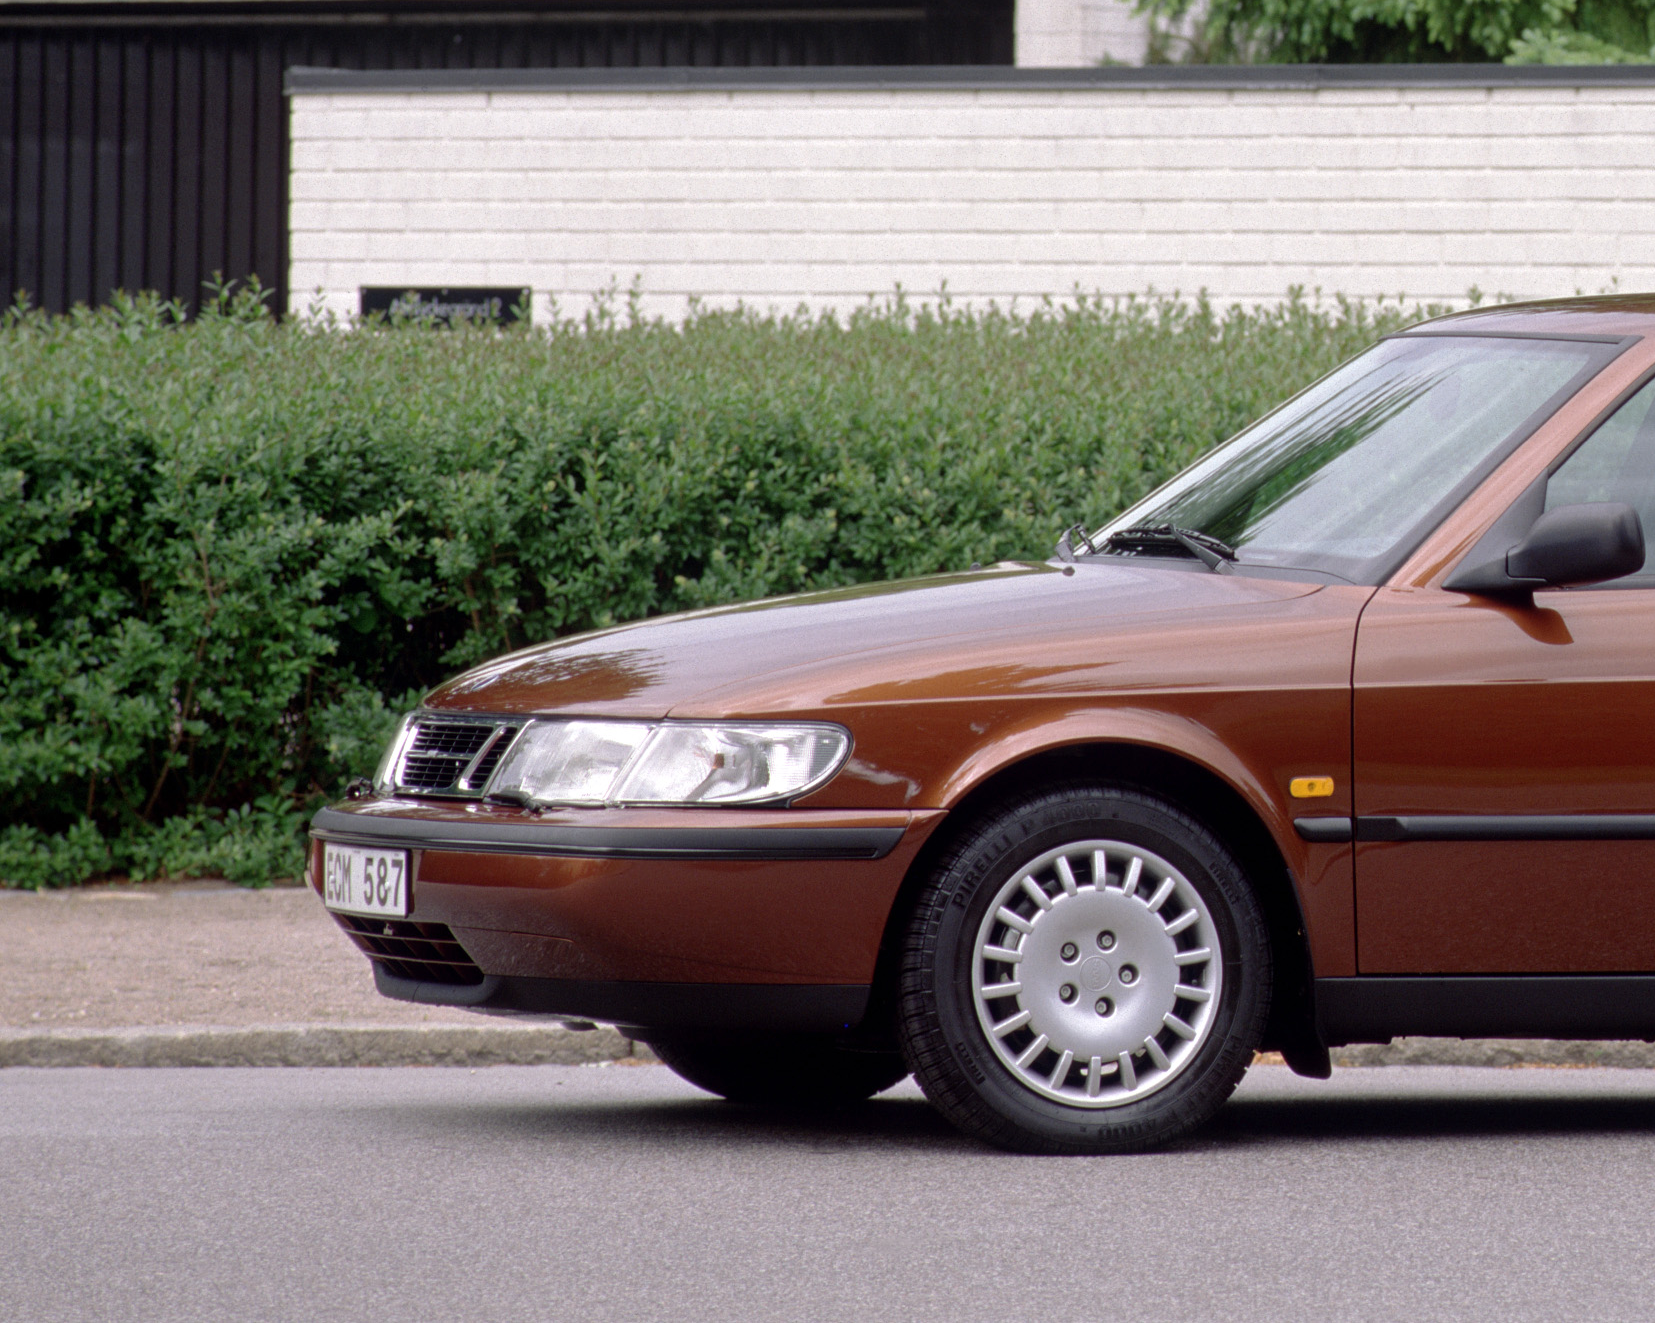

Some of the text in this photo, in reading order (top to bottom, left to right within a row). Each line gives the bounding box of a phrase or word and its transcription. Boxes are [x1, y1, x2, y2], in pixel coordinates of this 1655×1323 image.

[327, 851, 404, 908] ECM 587
[950, 833, 1013, 910] PIRELLI
[1019, 818, 1035, 836] P
[954, 1041, 986, 1086] PIRELLI
